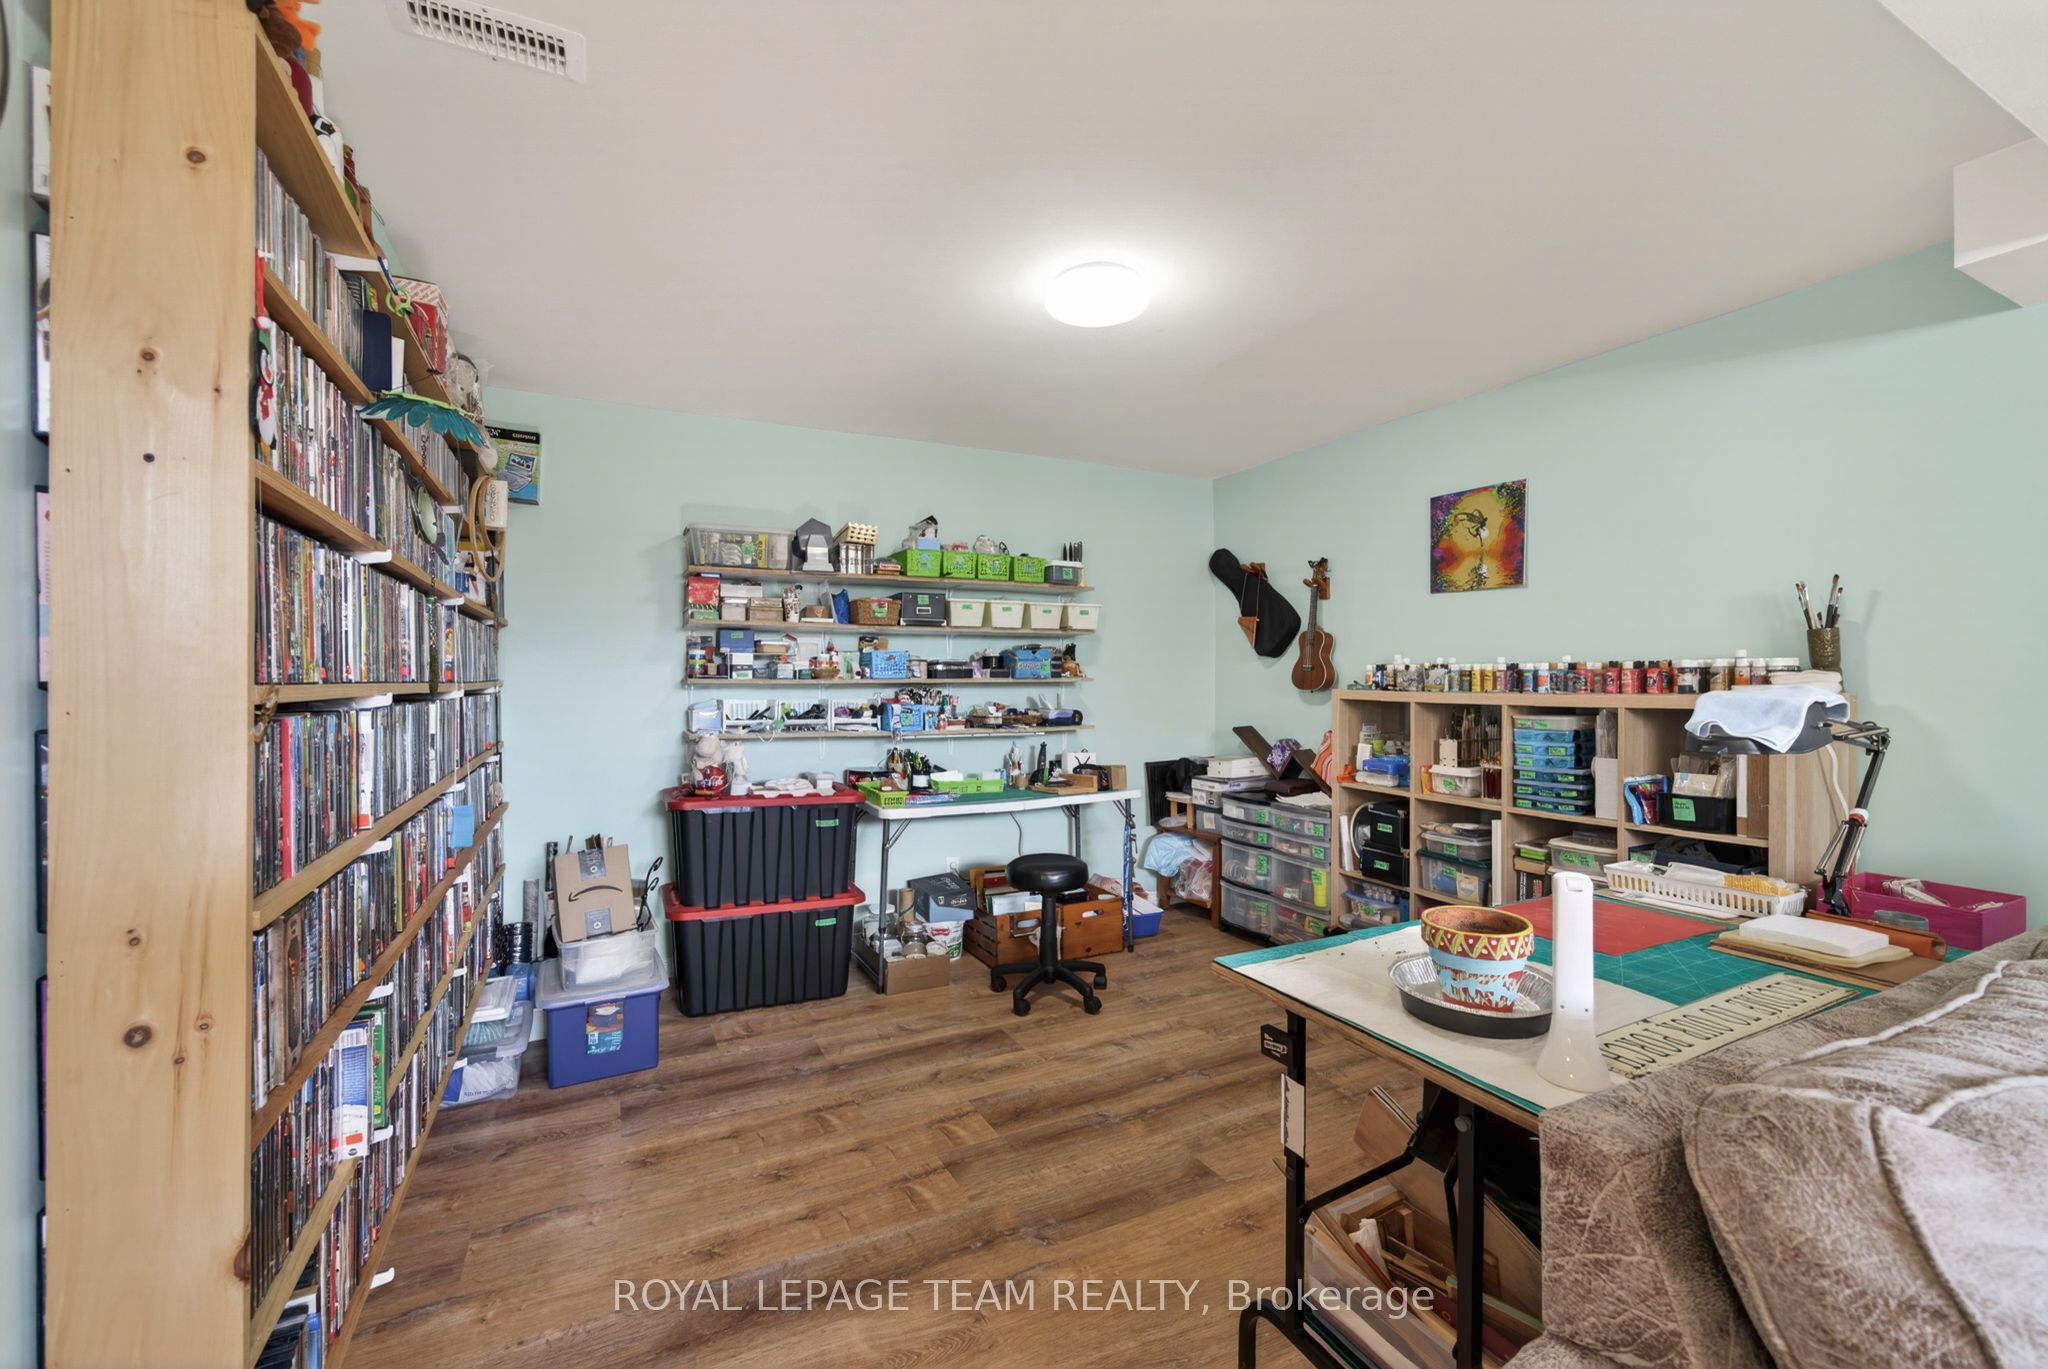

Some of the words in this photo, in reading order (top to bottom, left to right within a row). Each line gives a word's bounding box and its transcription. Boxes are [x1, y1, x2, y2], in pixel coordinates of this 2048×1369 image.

[1656, 1014, 1734, 1040] OUR
[1699, 1004, 1763, 1026] TO
[1599, 1028, 1694, 1069] PORCH
